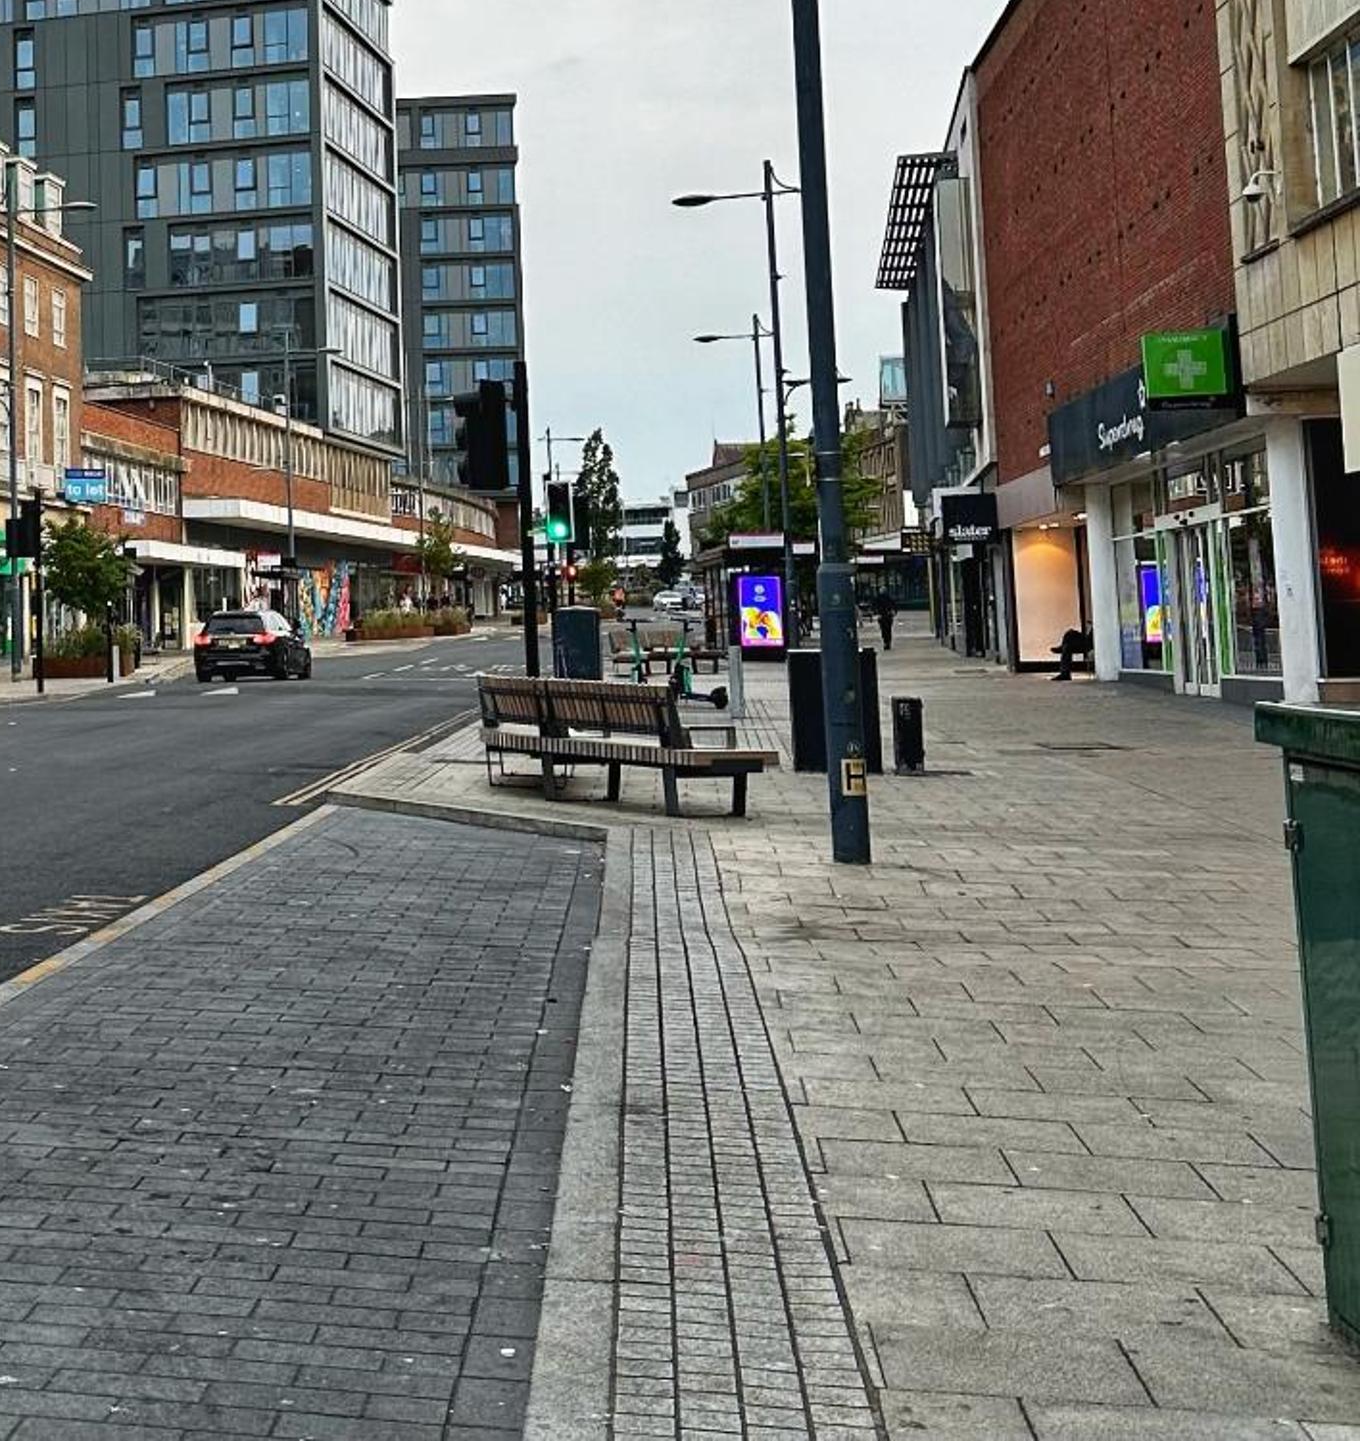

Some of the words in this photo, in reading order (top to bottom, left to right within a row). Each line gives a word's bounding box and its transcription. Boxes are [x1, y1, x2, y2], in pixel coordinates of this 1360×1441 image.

[1097, 413, 1145, 451] Superdrug
[66, 484, 82, 496] to
[85, 482, 104, 496] let
